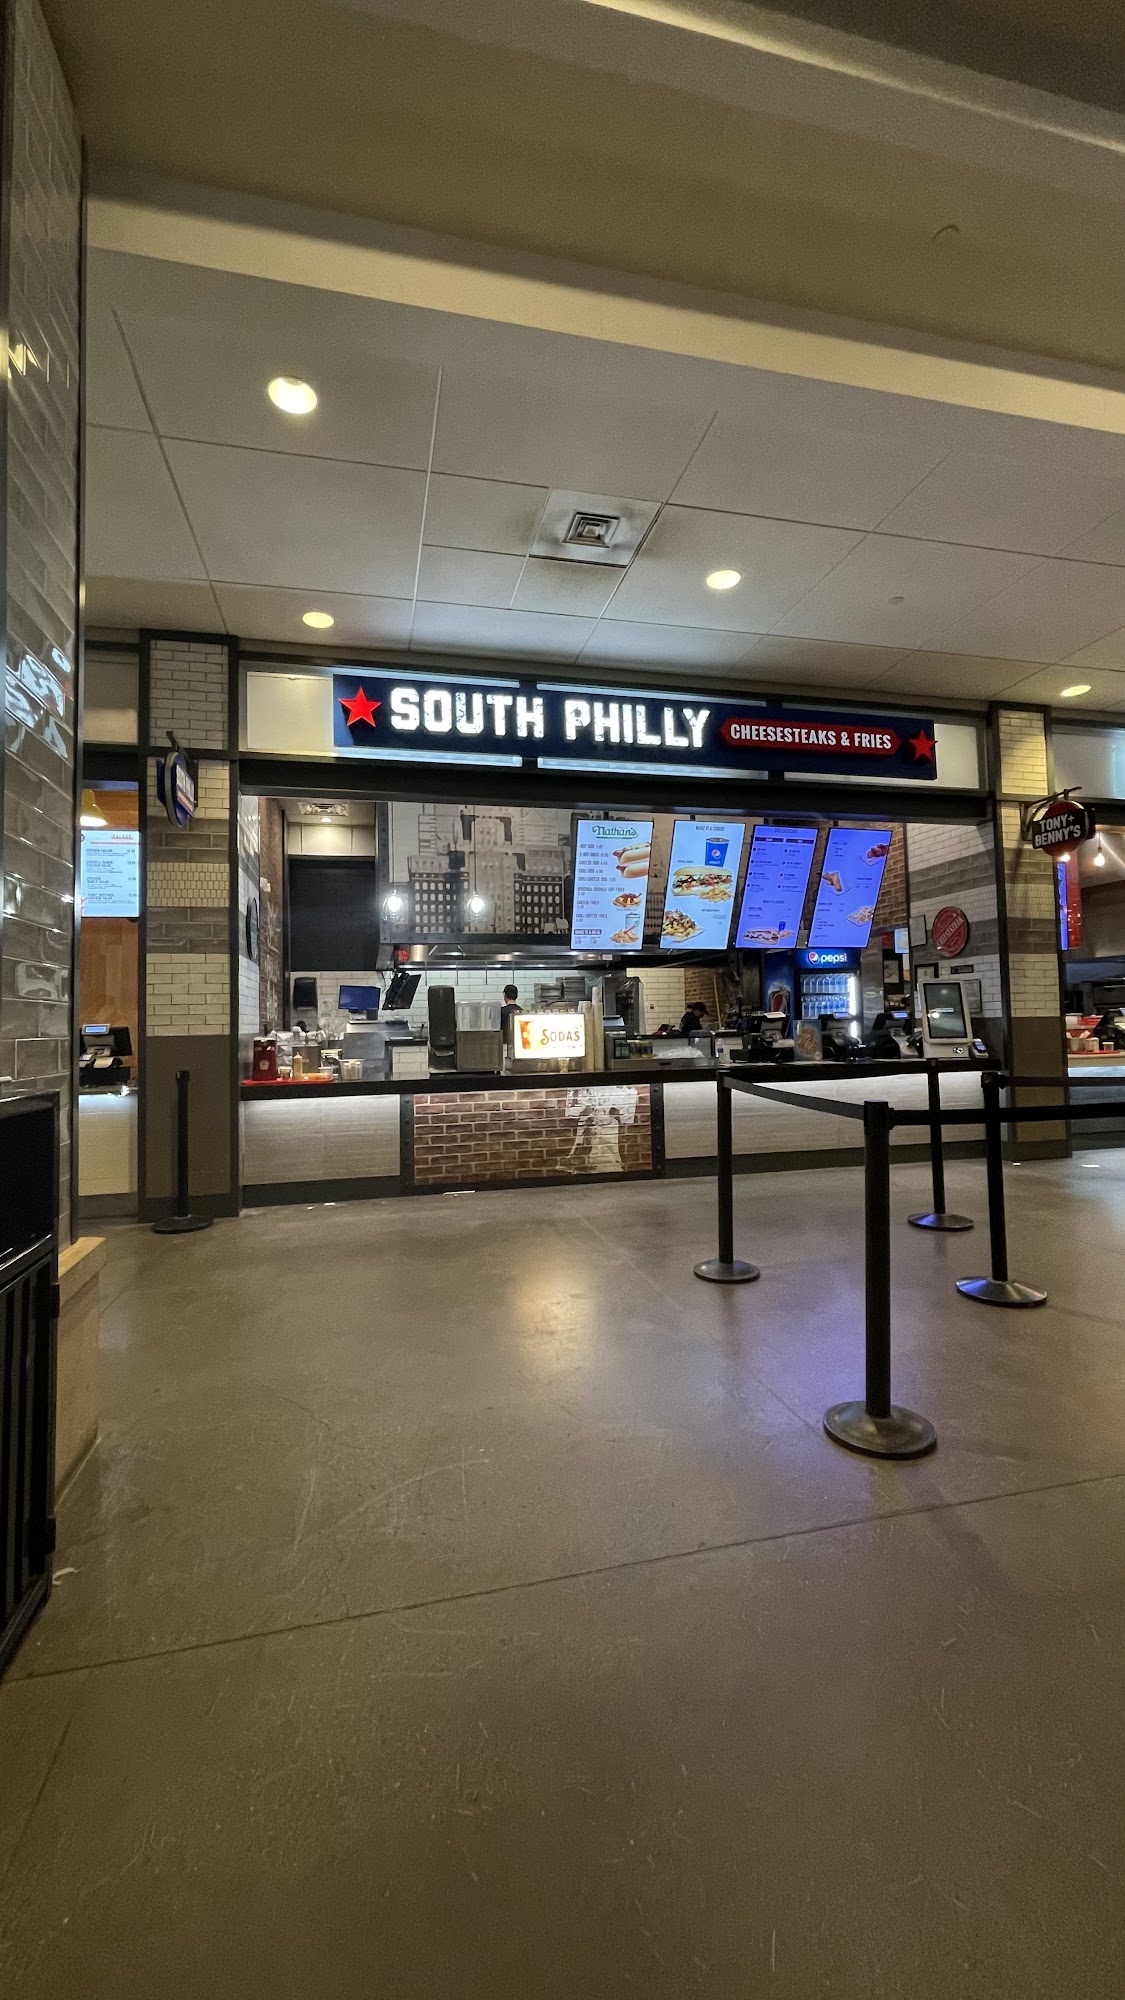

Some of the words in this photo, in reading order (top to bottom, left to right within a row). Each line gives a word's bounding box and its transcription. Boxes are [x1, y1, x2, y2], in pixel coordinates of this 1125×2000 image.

[390, 687, 544, 739] SOUTH
[564, 700, 710, 749] PHILLY
[730, 723, 837, 746] CHEESESTEAKS
[840, 731, 851, 746] &
[854, 733, 892, 749] FRIES
[592, 825, 637, 836] Nathan's
[1035, 825, 1081, 848] BENNY'S
[820, 953, 847, 964] pepsi
[540, 1028, 580, 1045] SODAS
